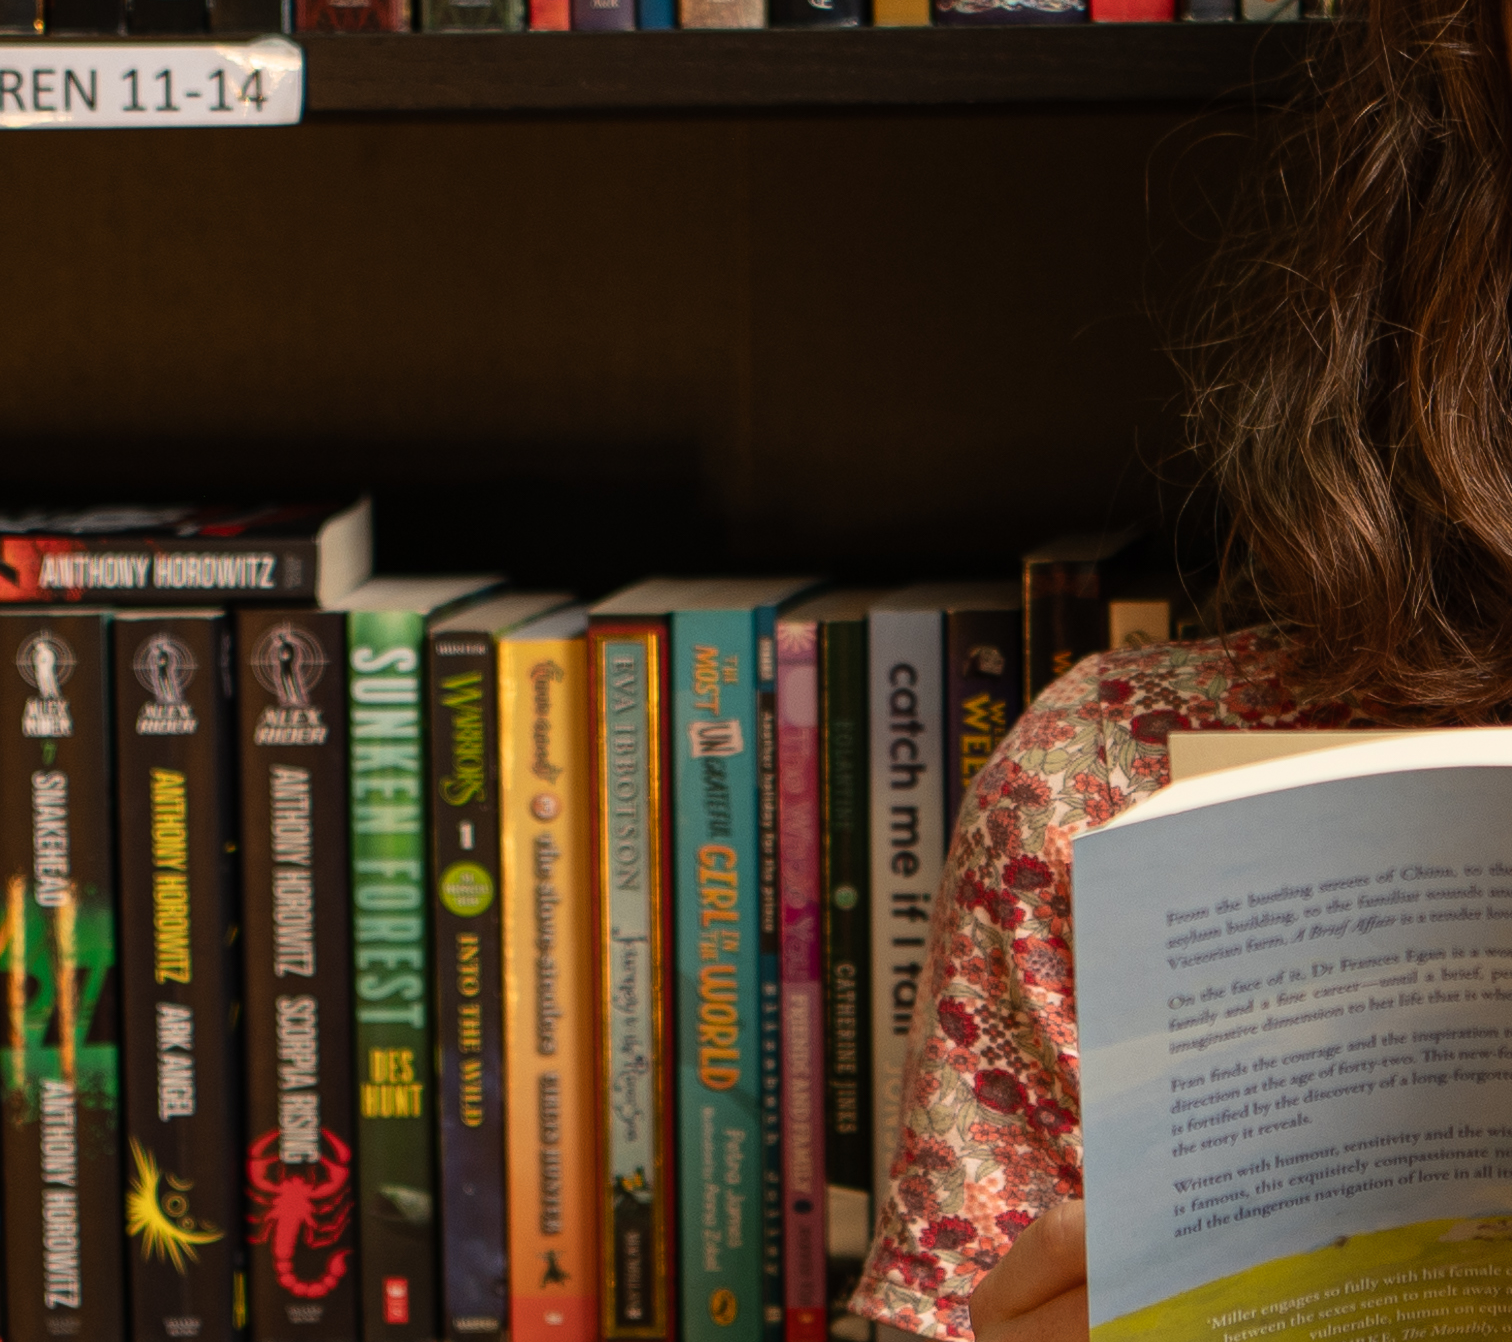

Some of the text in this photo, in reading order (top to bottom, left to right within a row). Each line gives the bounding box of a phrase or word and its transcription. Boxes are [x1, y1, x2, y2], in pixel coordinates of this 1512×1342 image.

[123, 69, 266, 114] 11-14
[39, 552, 147, 589] ANTHONY
[155, 552, 276, 589] HOROWITZ
[353, 648, 423, 1029] SUNKEN FOREST
